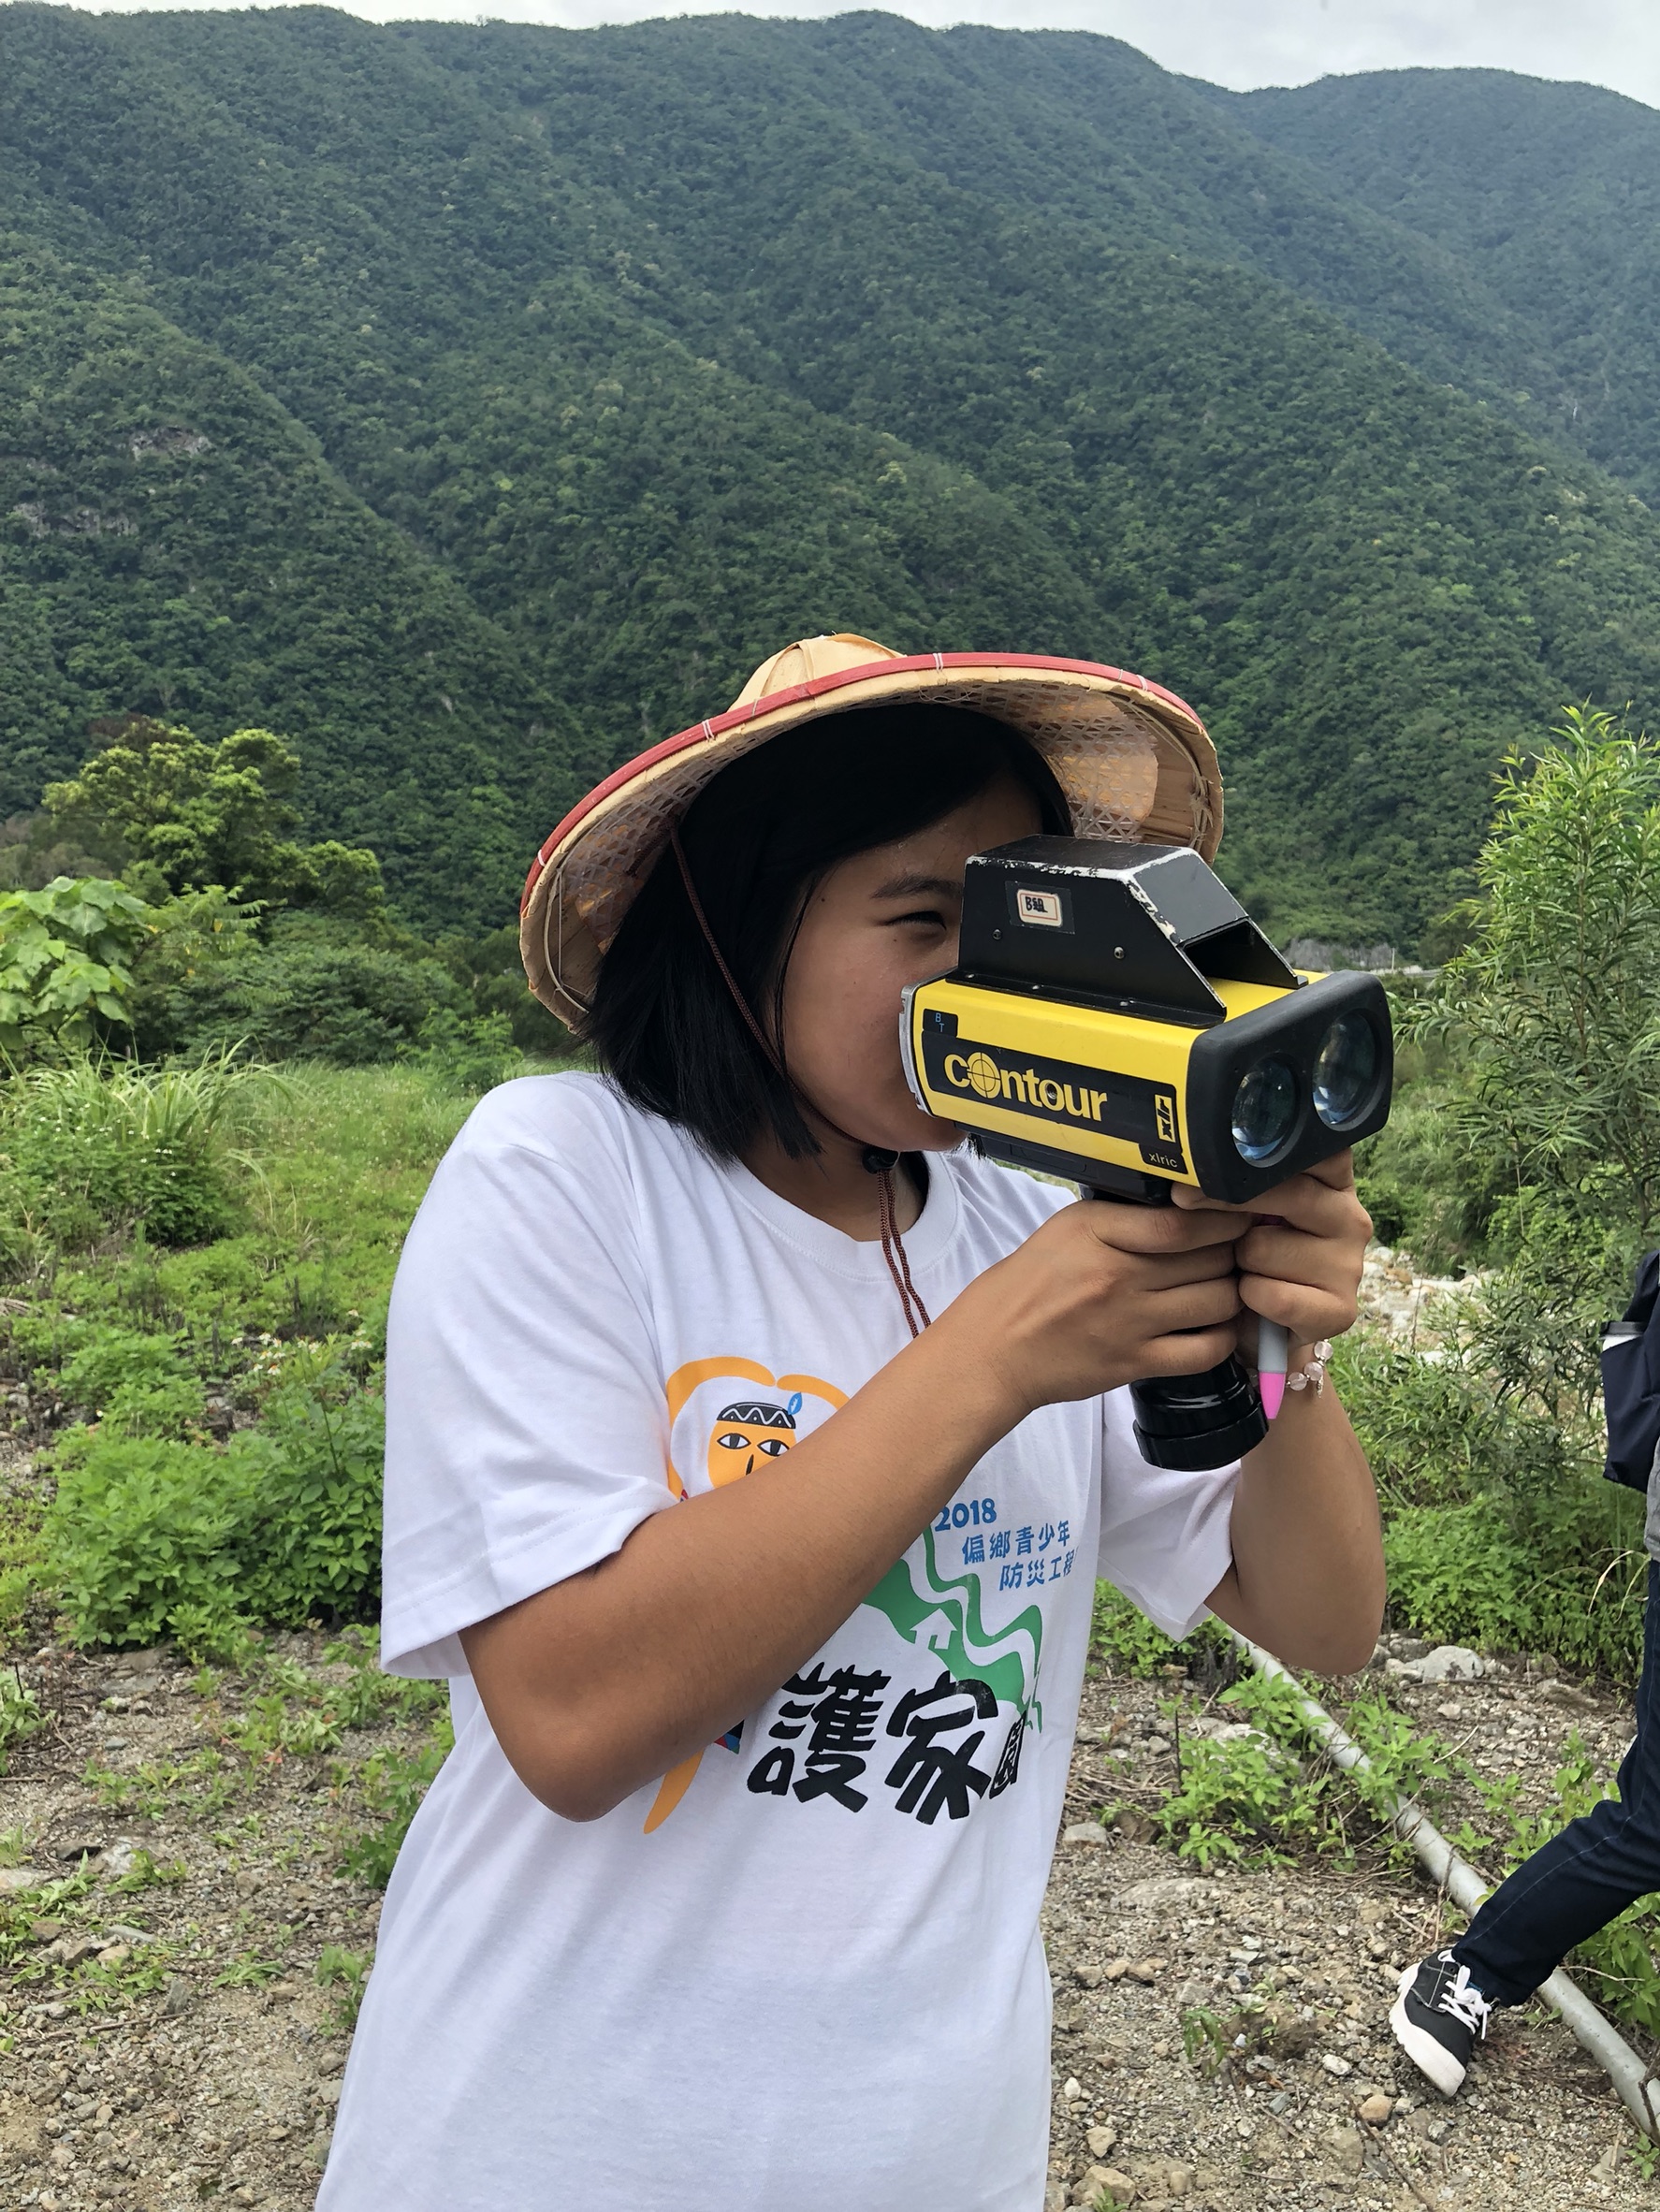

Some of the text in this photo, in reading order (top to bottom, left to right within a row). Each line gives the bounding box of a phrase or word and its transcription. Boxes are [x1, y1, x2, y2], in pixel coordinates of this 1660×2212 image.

[1148, 1152, 1178, 1168] xlric
[934, 1497, 997, 1532] 2018
[961, 1520, 1070, 1565] 偏鄉青少年
[998, 1545, 1078, 1592] 防災工程
